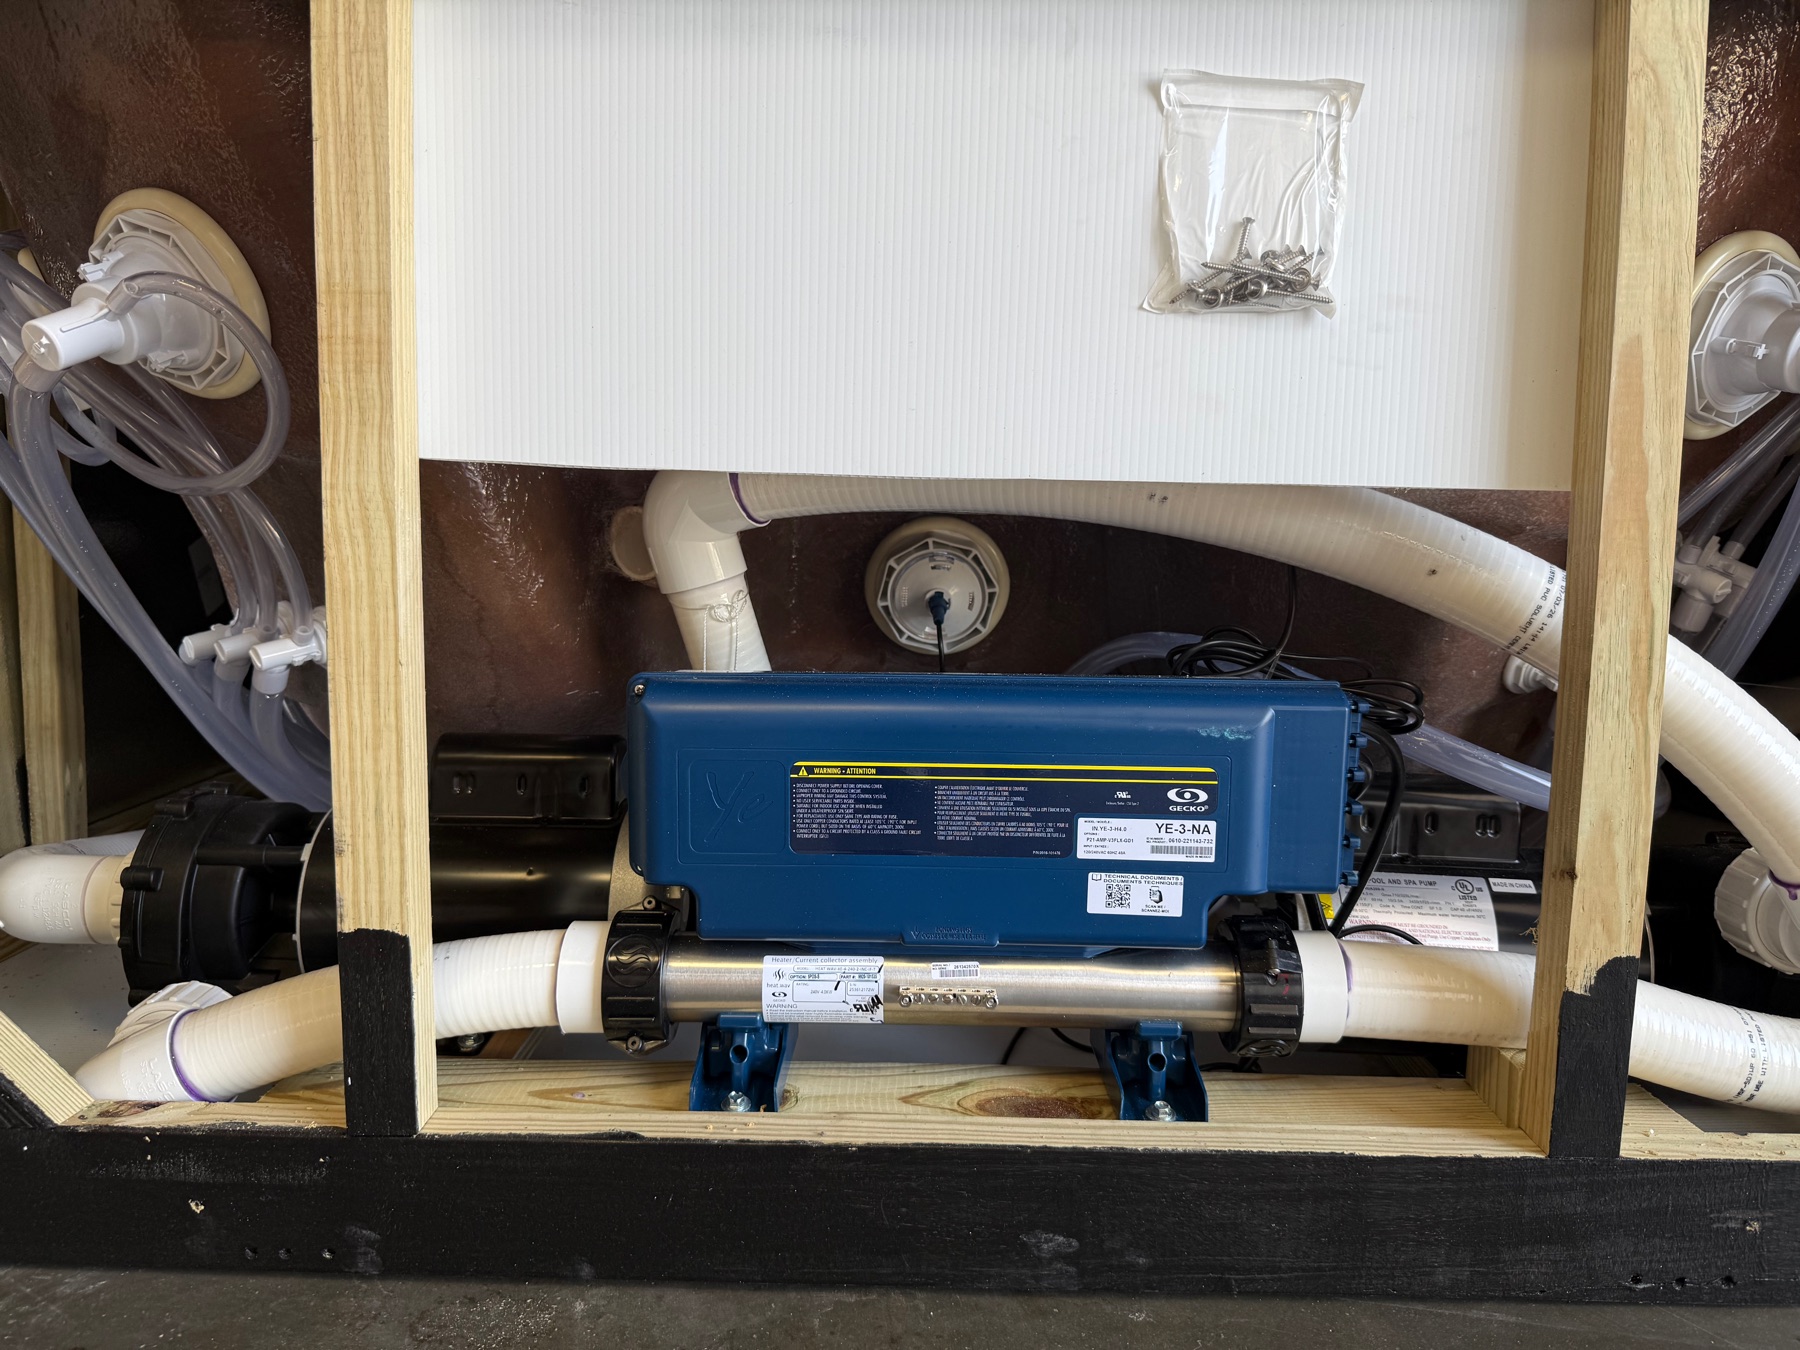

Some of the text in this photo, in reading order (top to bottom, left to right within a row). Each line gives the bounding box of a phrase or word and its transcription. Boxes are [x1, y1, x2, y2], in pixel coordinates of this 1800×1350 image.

[1548, 566, 1556, 585] LISTED
[1518, 604, 1542, 634] SOLVENT
[1156, 823, 1211, 834] YE-3-NA
